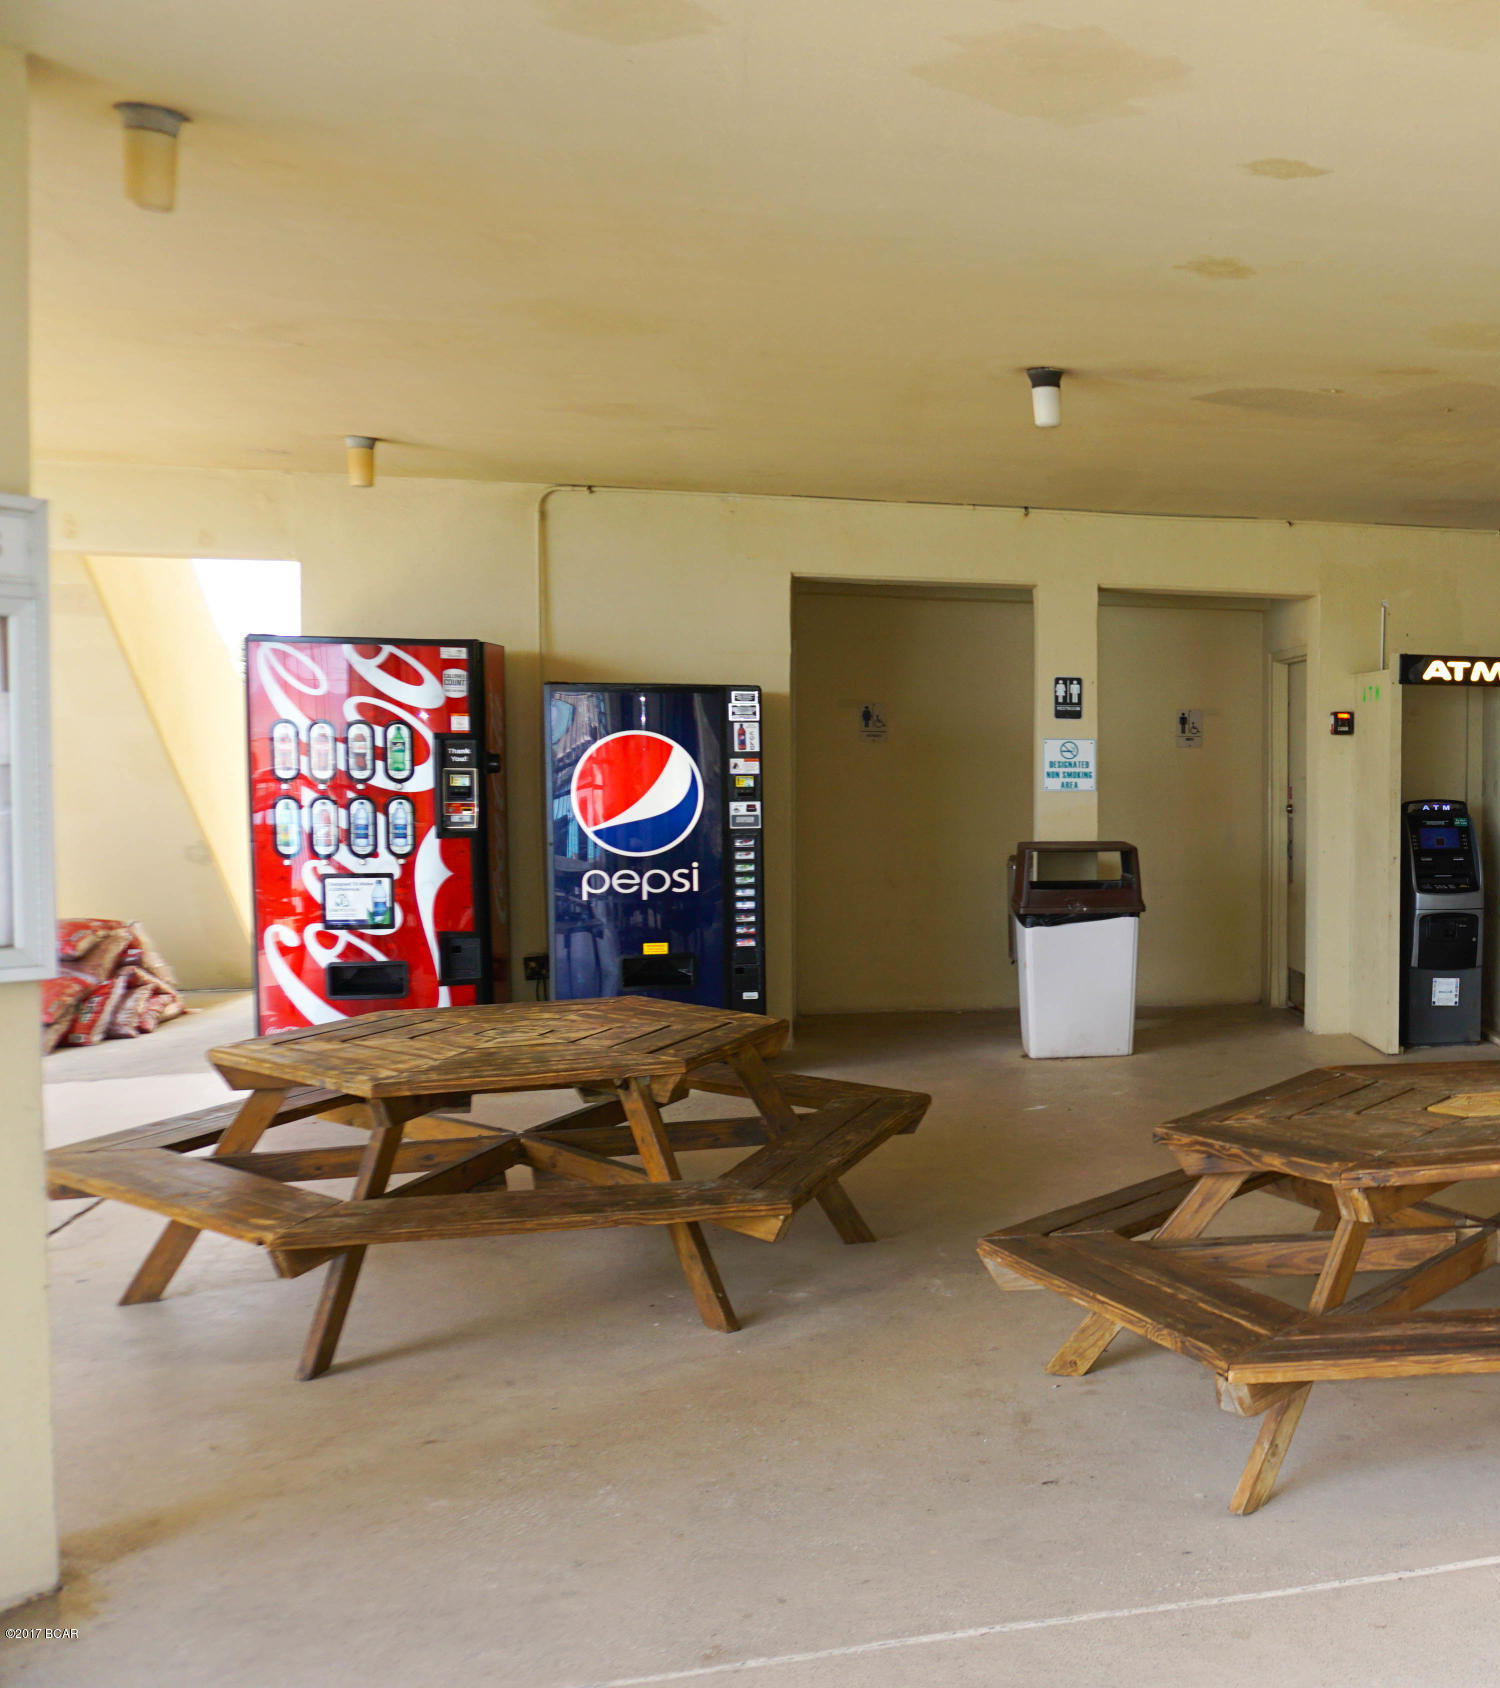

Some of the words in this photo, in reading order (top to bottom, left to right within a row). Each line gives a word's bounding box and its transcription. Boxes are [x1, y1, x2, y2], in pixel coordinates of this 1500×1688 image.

[1048, 760, 1090, 769] DESIGNATED
[1046, 771, 1060, 779] NON
[1062, 771, 1093, 779] SMOKING
[1060, 781, 1078, 789] AREA
[581, 861, 699, 900] pepsi
